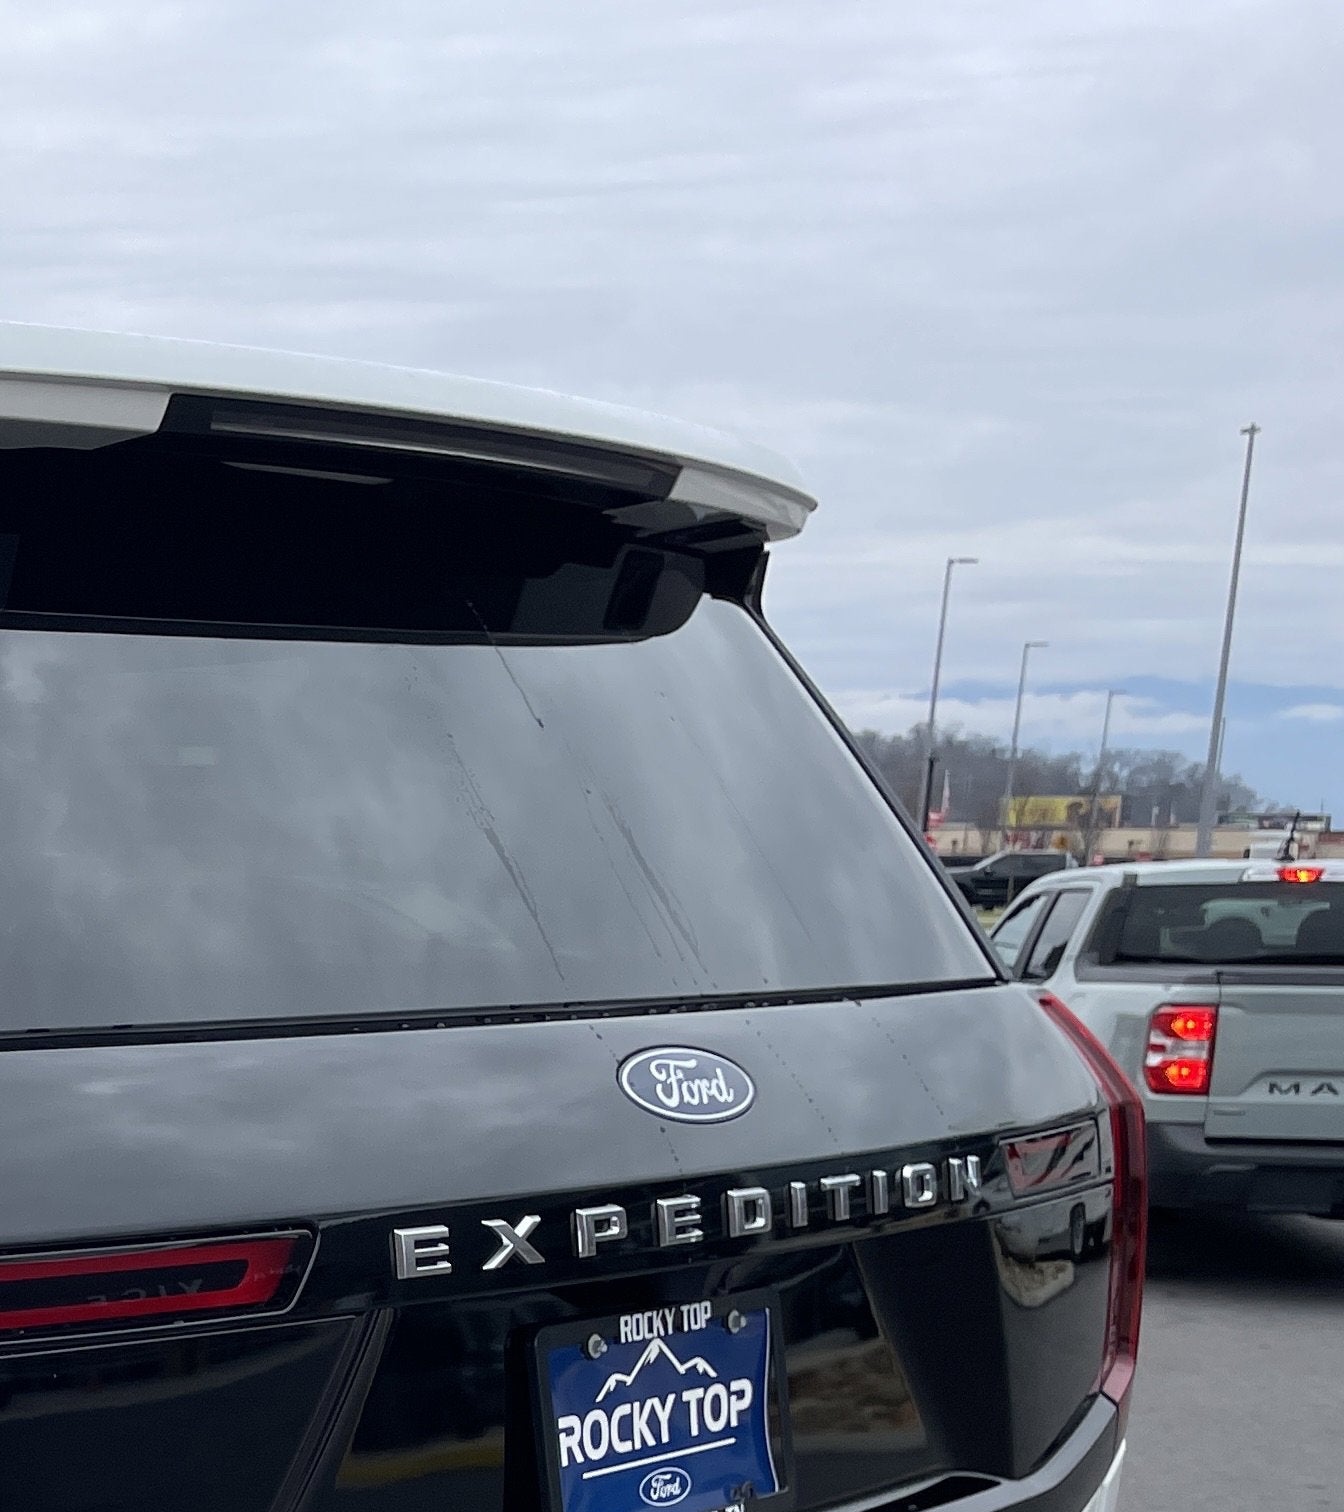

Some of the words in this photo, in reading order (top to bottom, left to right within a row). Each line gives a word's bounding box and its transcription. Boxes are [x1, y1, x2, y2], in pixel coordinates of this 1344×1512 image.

[391, 1154, 982, 1281] EXPEDITION
[619, 1306, 676, 1344] ROCKY
[680, 1301, 712, 1333] TOP
[557, 1393, 677, 1468] ROCKY
[682, 1378, 753, 1438] TOP
